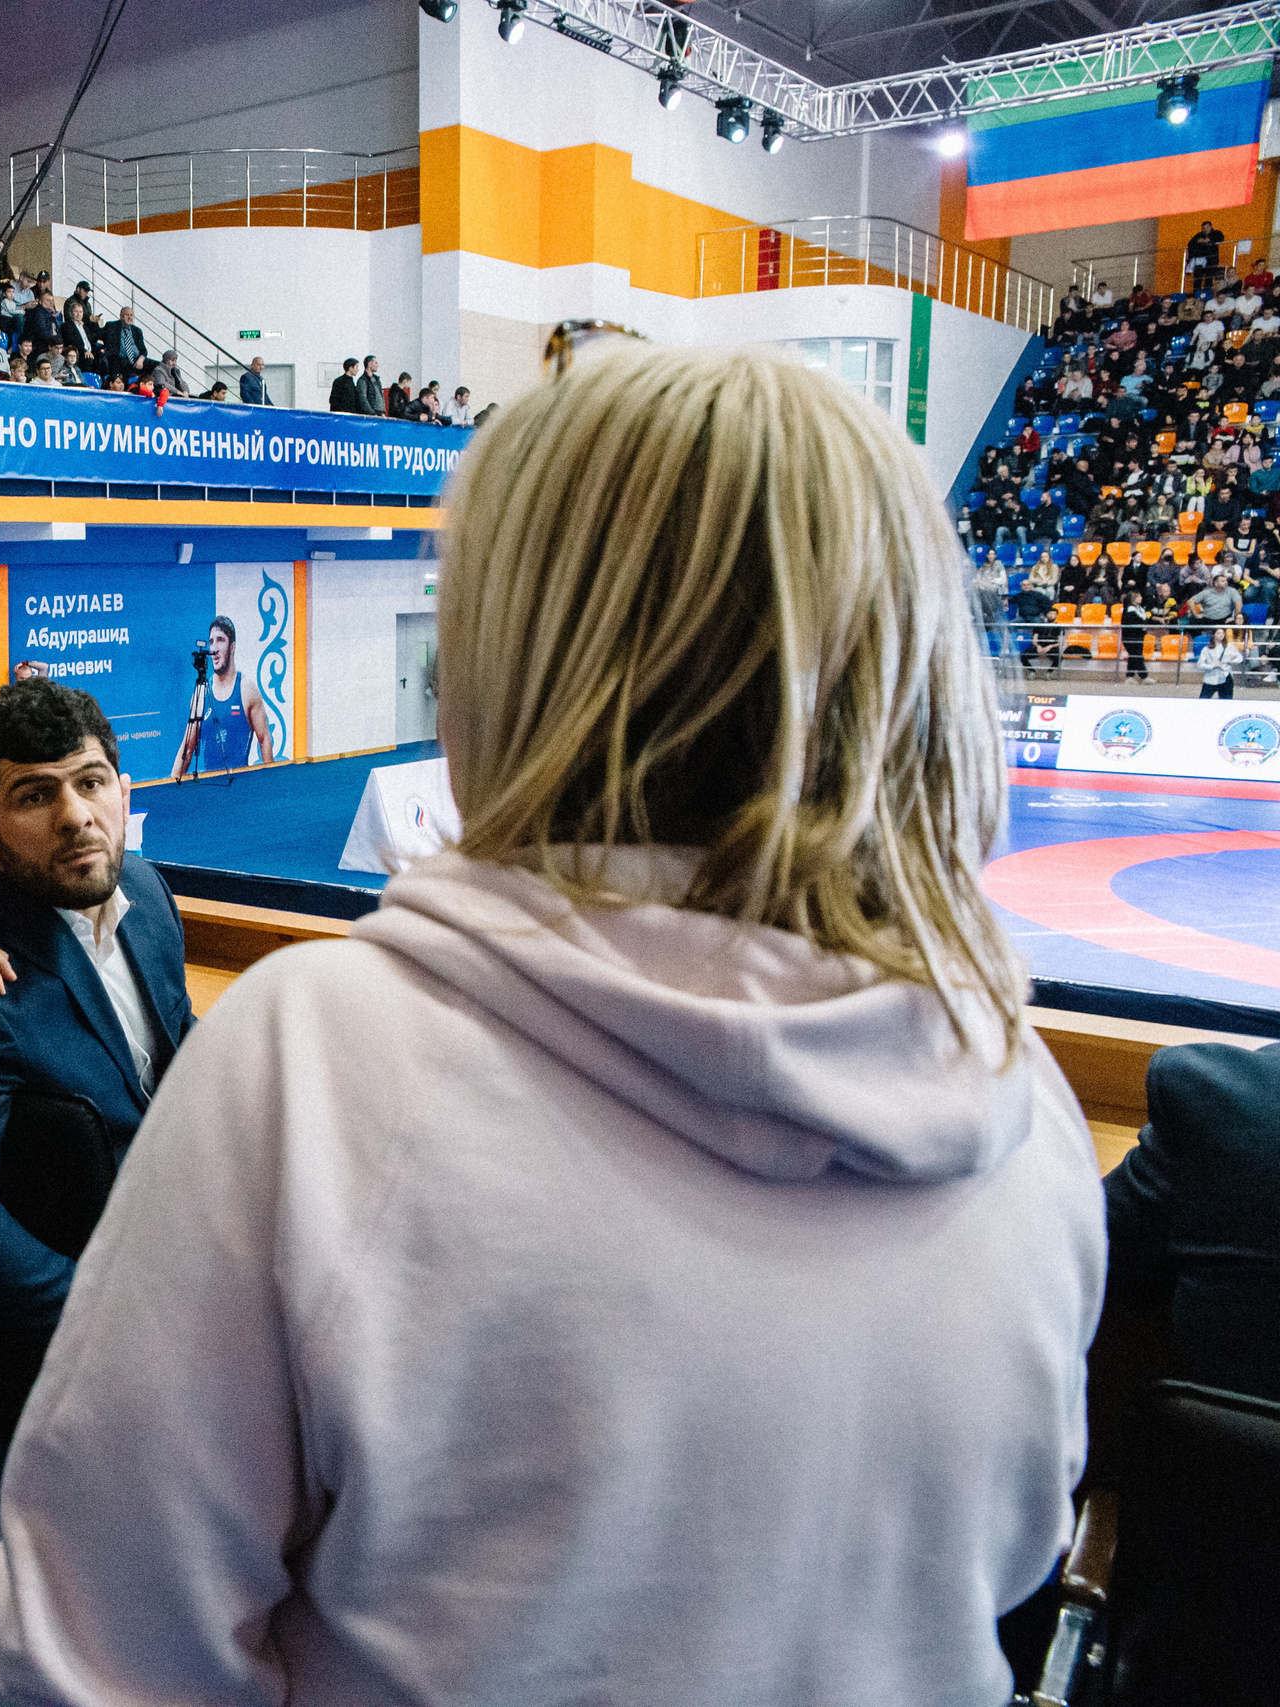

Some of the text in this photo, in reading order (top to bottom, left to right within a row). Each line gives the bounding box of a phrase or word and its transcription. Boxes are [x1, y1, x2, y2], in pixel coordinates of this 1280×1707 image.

[44, 419, 264, 462] ПРИУМНОЖЕННЫЙ
[269, 436, 380, 468] ОГРОМНЫМ
[25, 593, 124, 618] САДУЛАЕВ
[26, 627, 130, 651] Абдулрашид
[31, 659, 113, 678] лачевич
[1027, 695, 1056, 704] Tour
[995, 709, 1022, 722] WW
[1053, 731, 1062, 741] 2
[1023, 742, 1041, 762] 0
